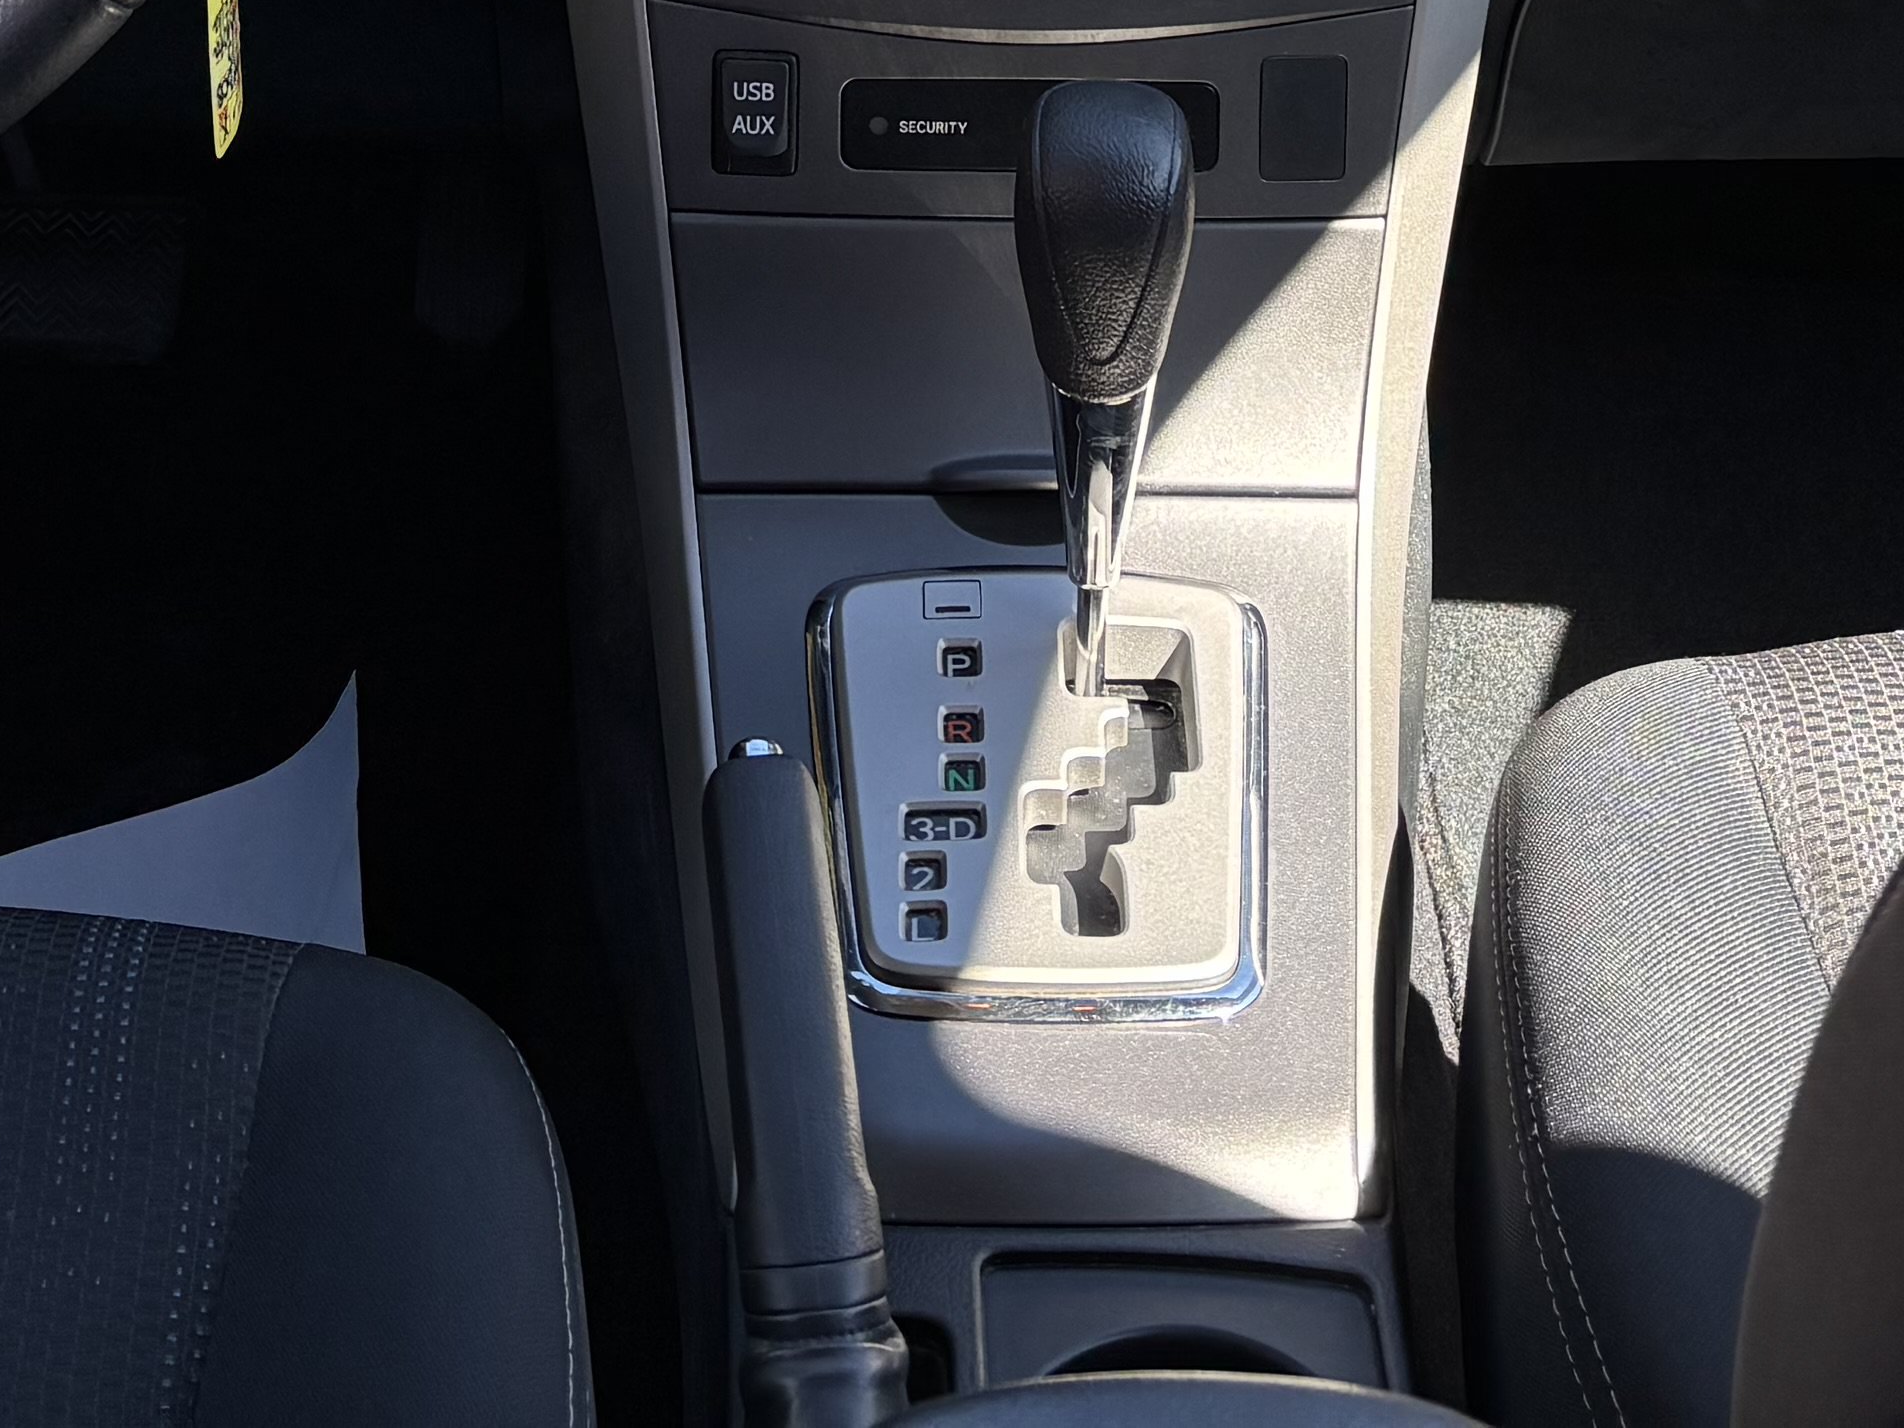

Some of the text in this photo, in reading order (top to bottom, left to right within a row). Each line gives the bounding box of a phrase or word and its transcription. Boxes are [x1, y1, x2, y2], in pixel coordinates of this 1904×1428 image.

[733, 81, 776, 102] USB
[731, 114, 776, 136] AUX
[897, 119, 968, 136] SECURITY
[946, 652, 972, 678] P
[946, 719, 972, 743] R
[947, 768, 975, 792] N
[909, 816, 977, 841] 3-D
[913, 866, 934, 891] 2
[911, 916, 937, 941] L
